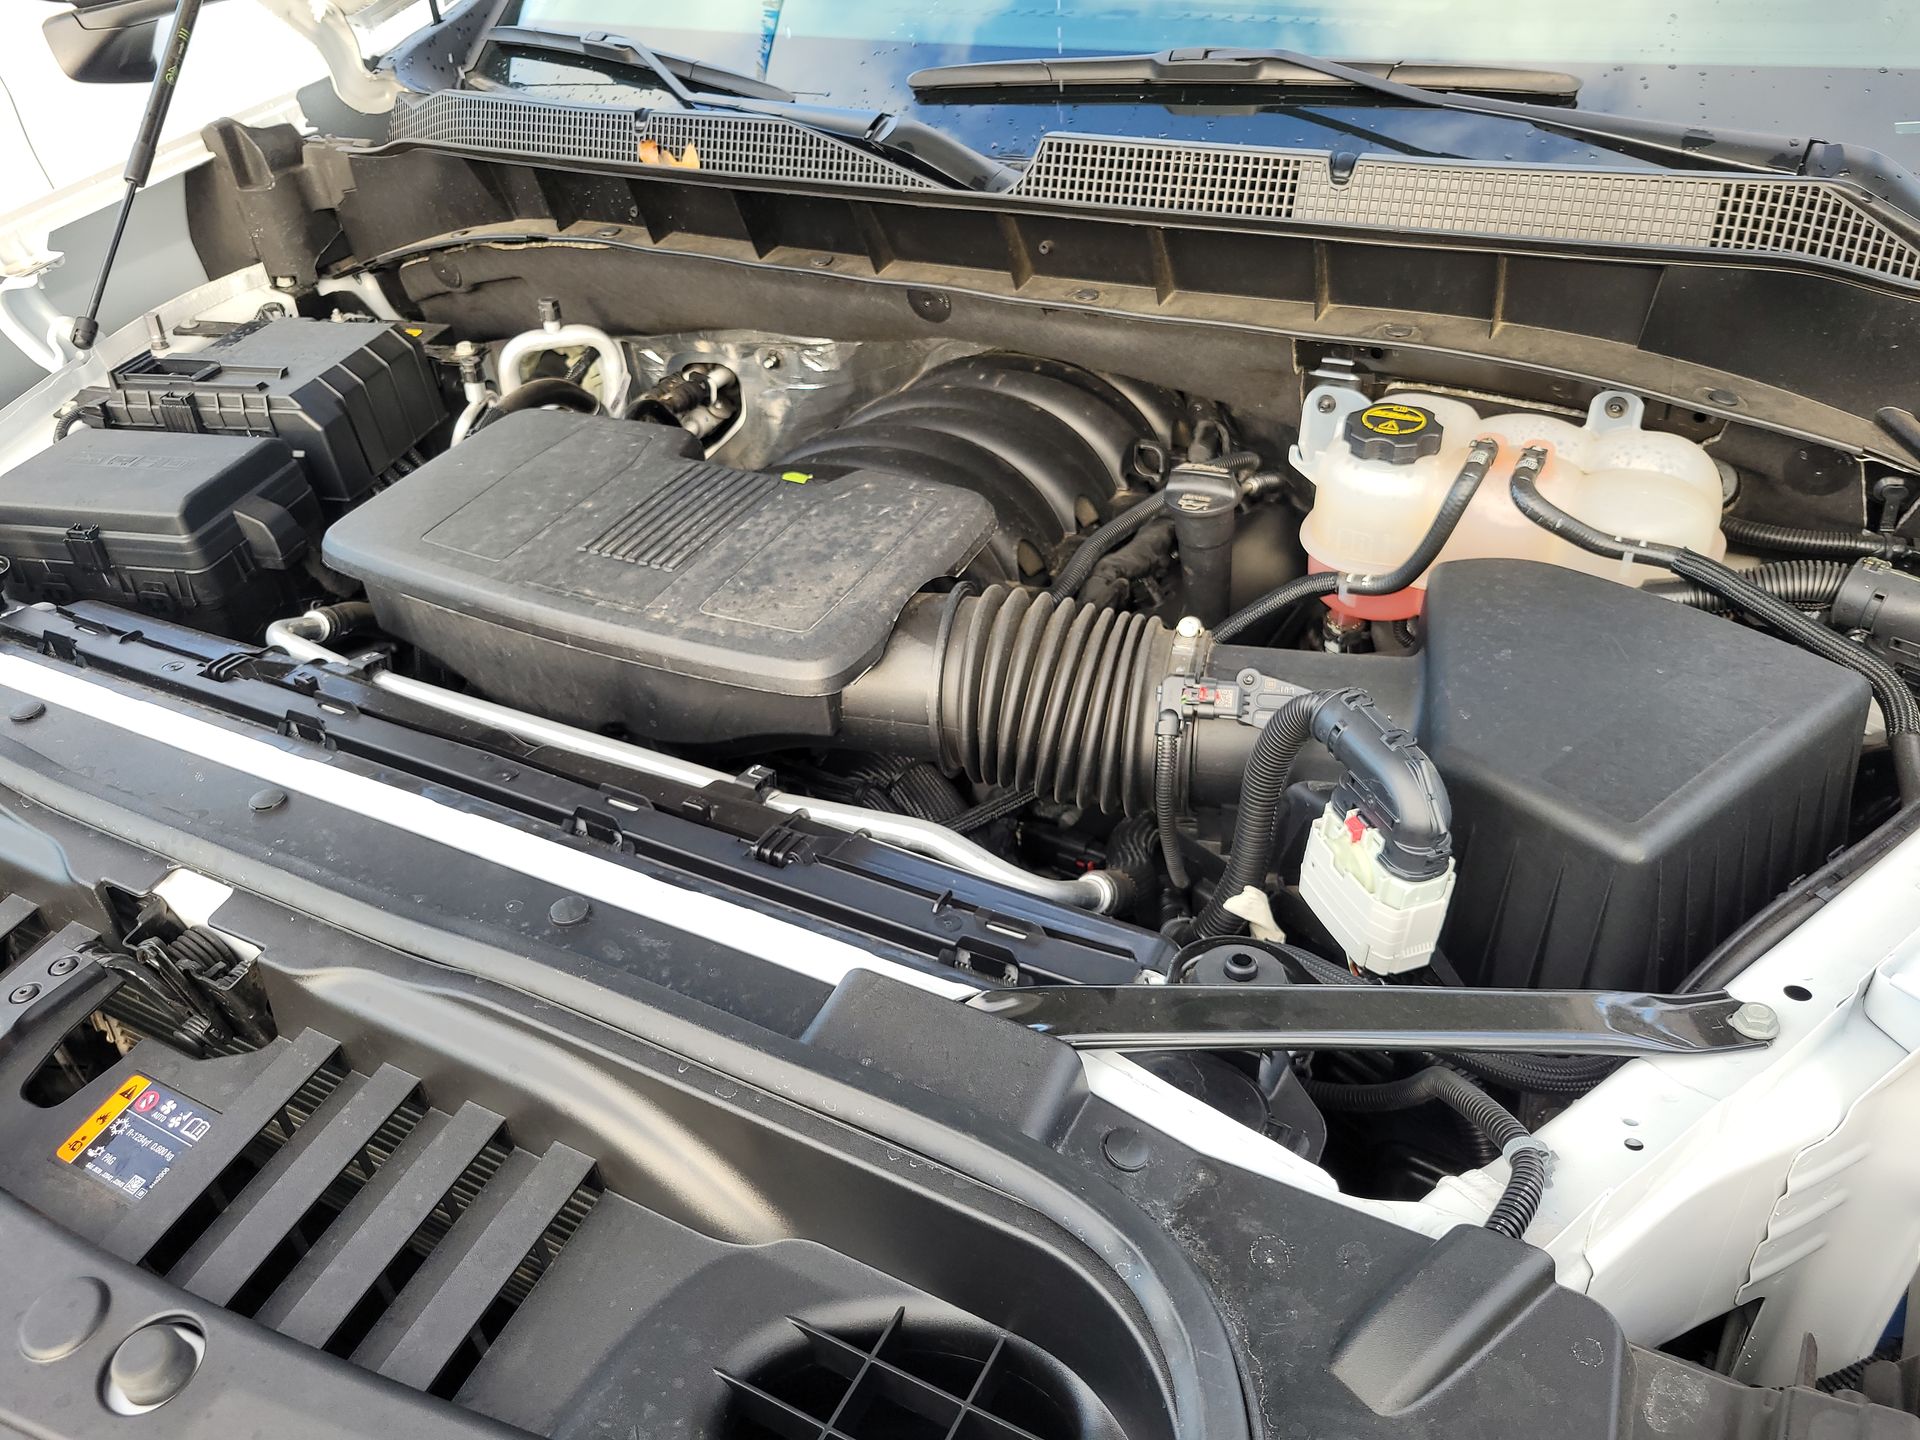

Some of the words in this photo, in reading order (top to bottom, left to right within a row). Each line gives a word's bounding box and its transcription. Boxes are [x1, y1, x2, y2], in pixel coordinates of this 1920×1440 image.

[151, 1111, 167, 1122] AUTO
[126, 1129, 153, 1147] R-1234yf
[165, 1151, 175, 1161] kg
[102, 1153, 117, 1165] PAG
